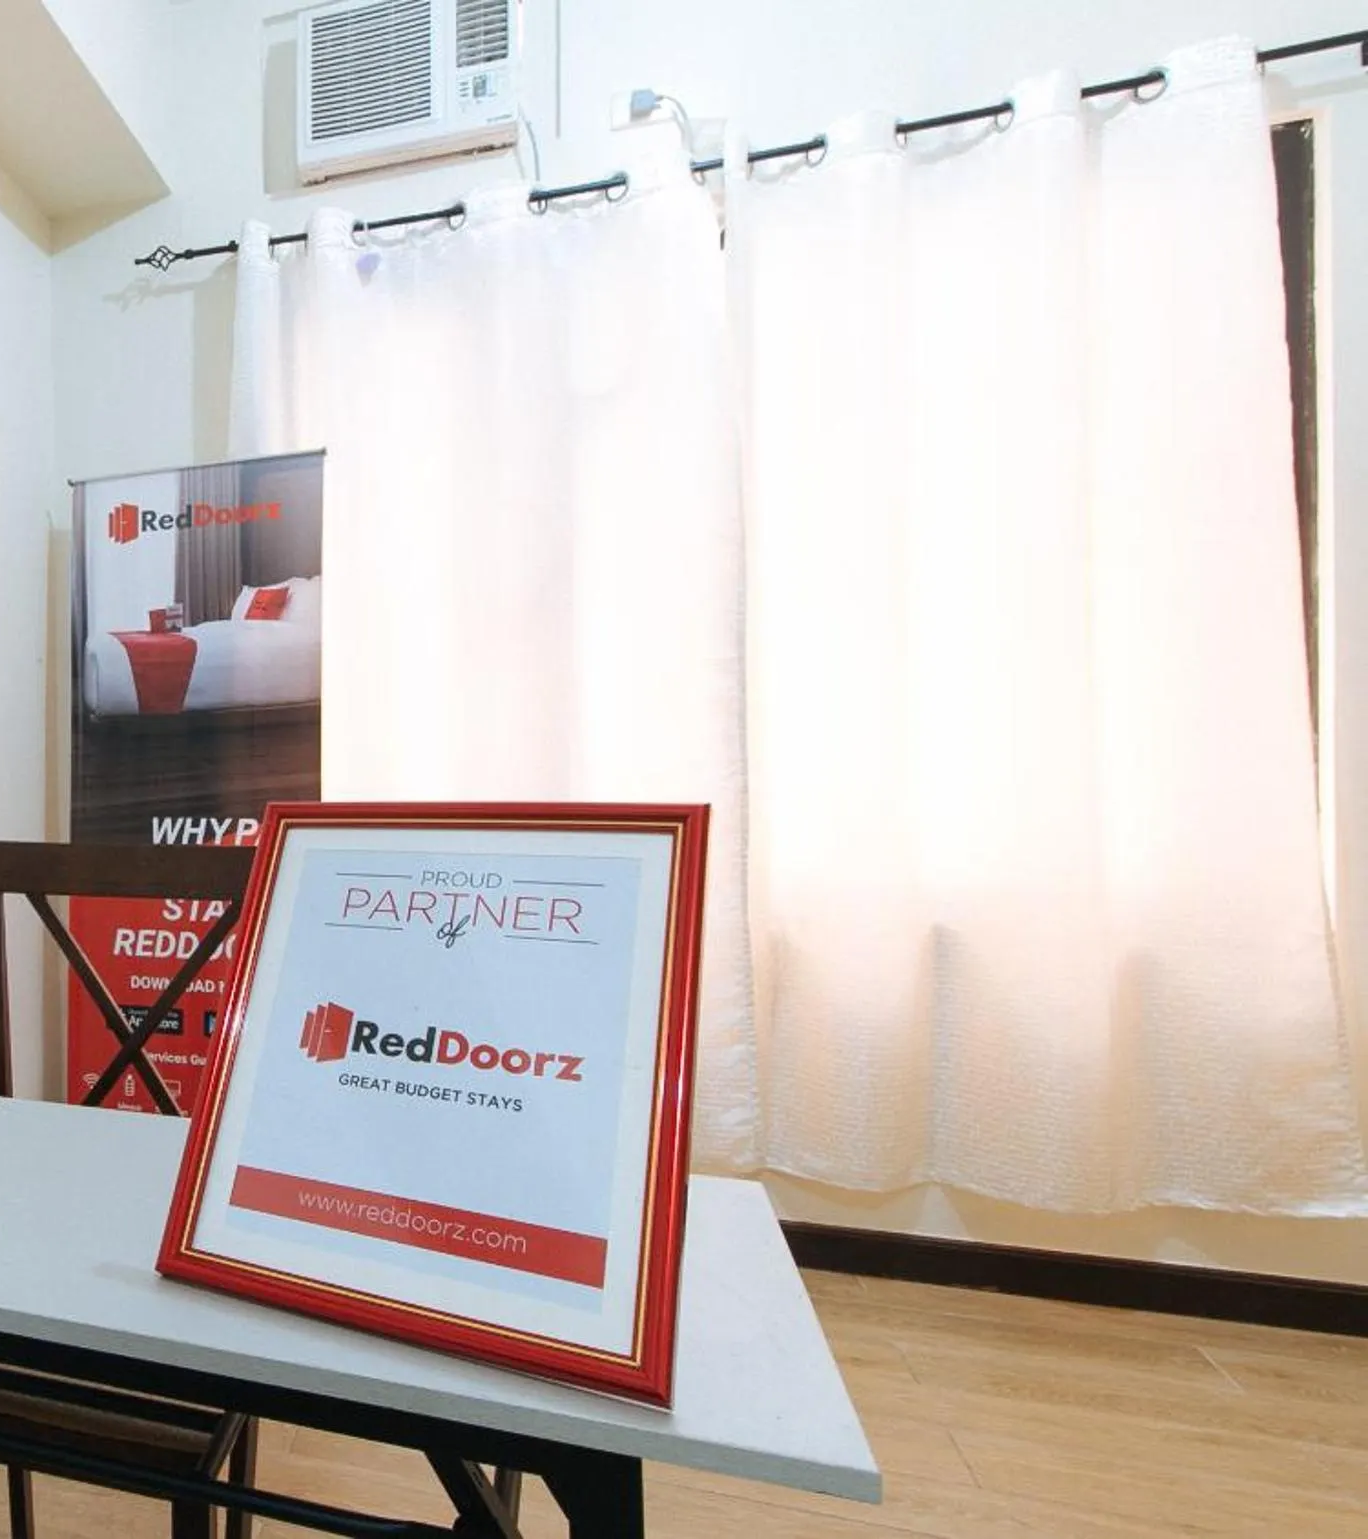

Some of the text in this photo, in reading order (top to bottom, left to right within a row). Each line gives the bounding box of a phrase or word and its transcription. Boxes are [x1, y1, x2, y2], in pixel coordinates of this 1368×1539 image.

[141, 502, 282, 532] RedDoorz
[151, 816, 260, 847] WHY P
[419, 869, 503, 890] PROUD
[162, 898, 232, 922] STA
[341, 887, 583, 935] PARTNER
[435, 914, 471, 949] of
[146, 1051, 188, 1065] ervices
[350, 1019, 586, 1083] RedDoorz
[338, 1073, 523, 1112] GREAT BUDGET STAYS
[297, 1188, 527, 1254] www.reddoorz.com
